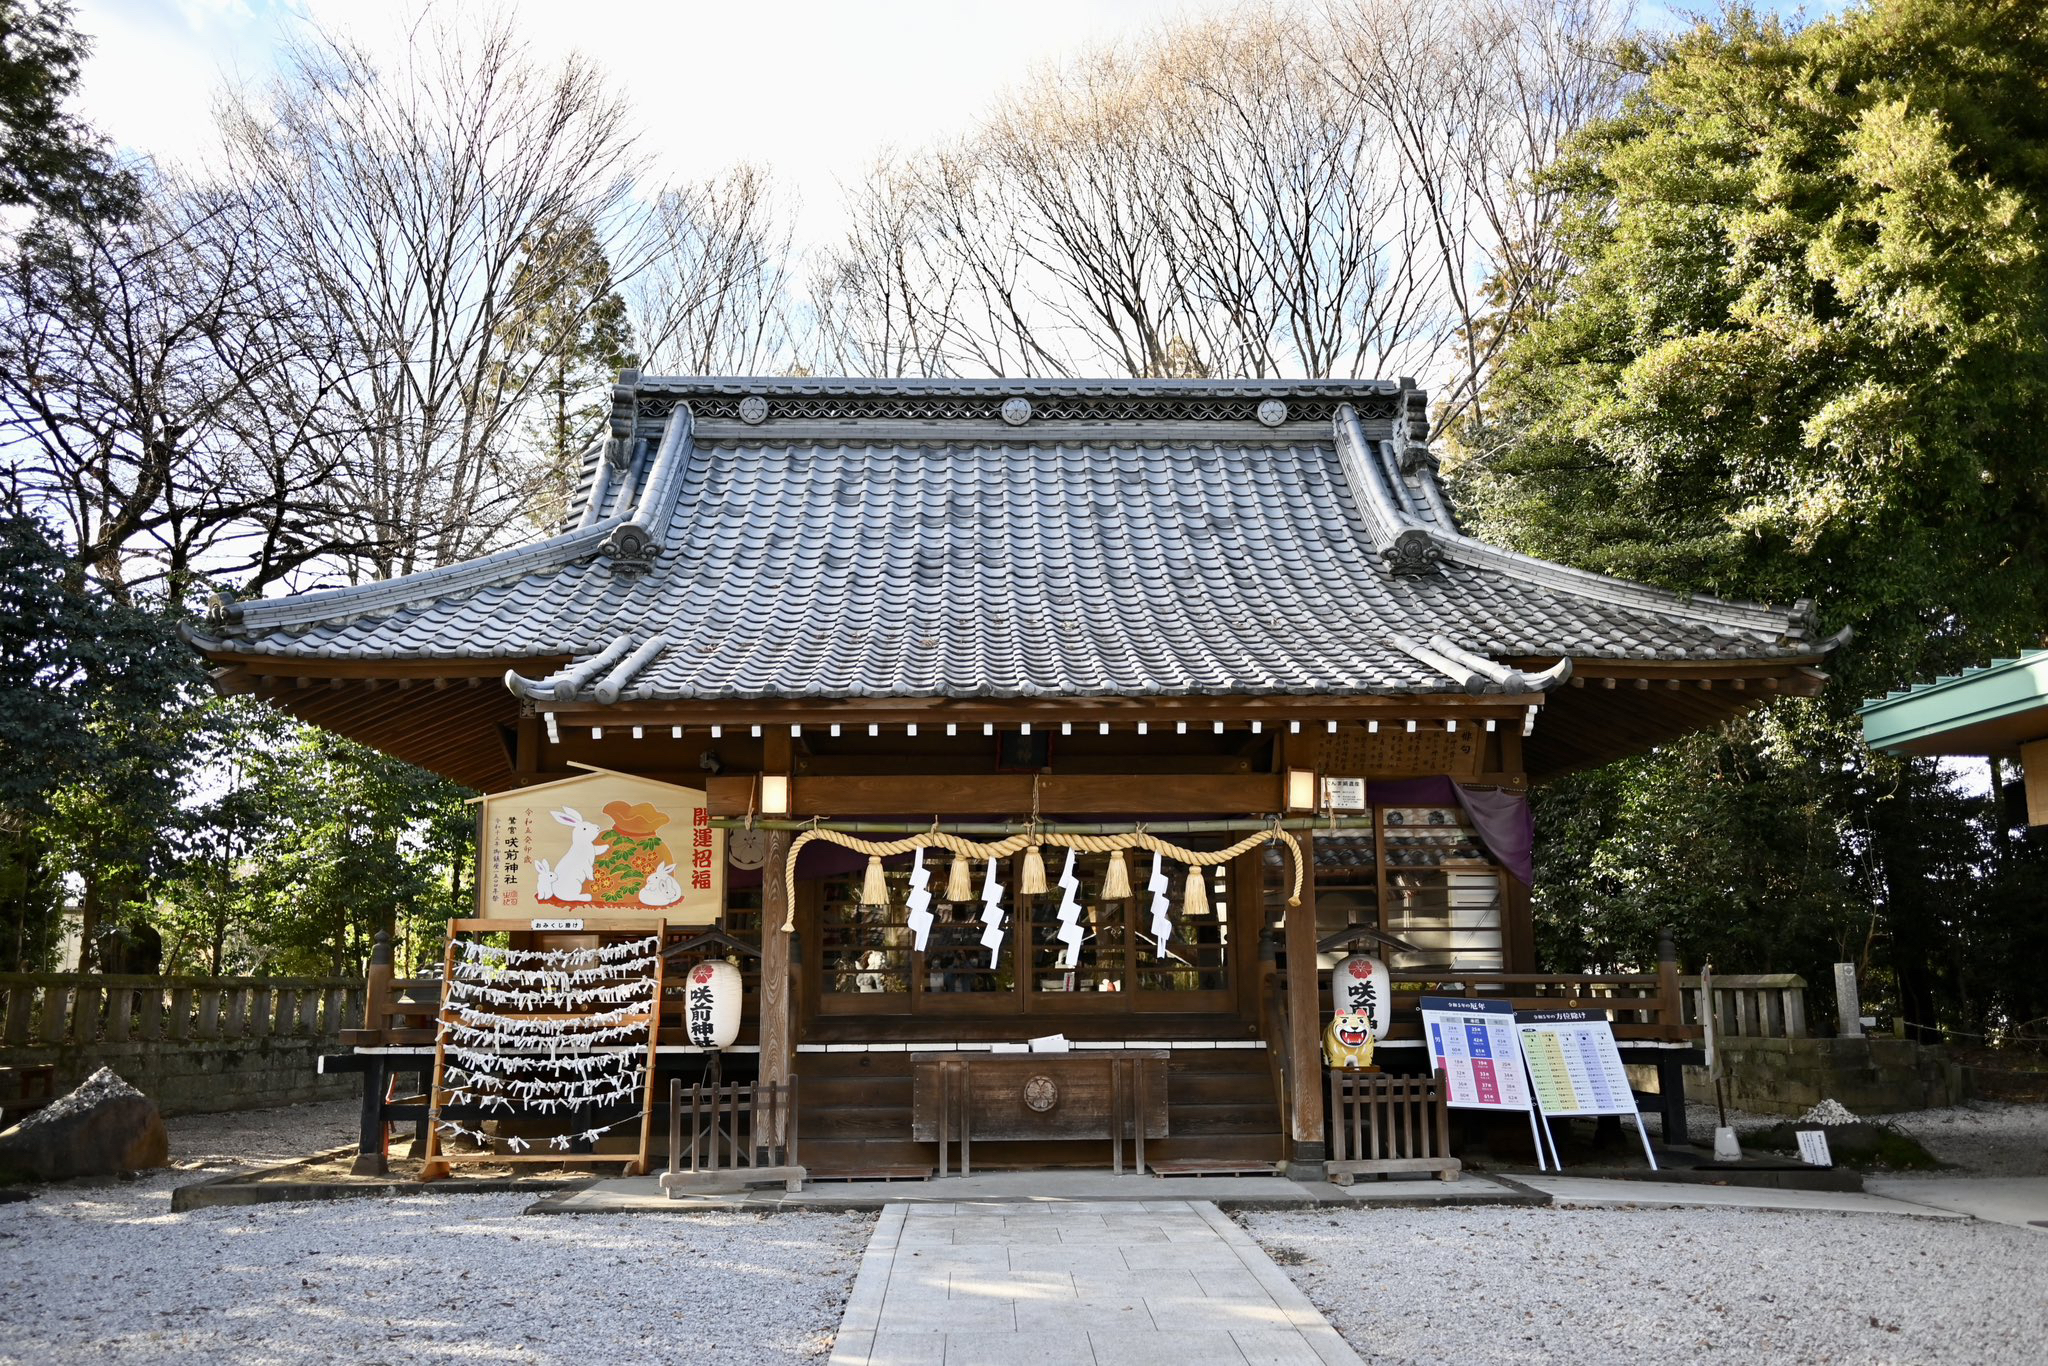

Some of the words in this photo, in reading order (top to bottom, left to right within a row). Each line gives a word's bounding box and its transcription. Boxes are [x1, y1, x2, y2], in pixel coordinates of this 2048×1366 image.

[691, 807, 712, 889] 開運招福
[690, 985, 718, 1048] 咲前神社
